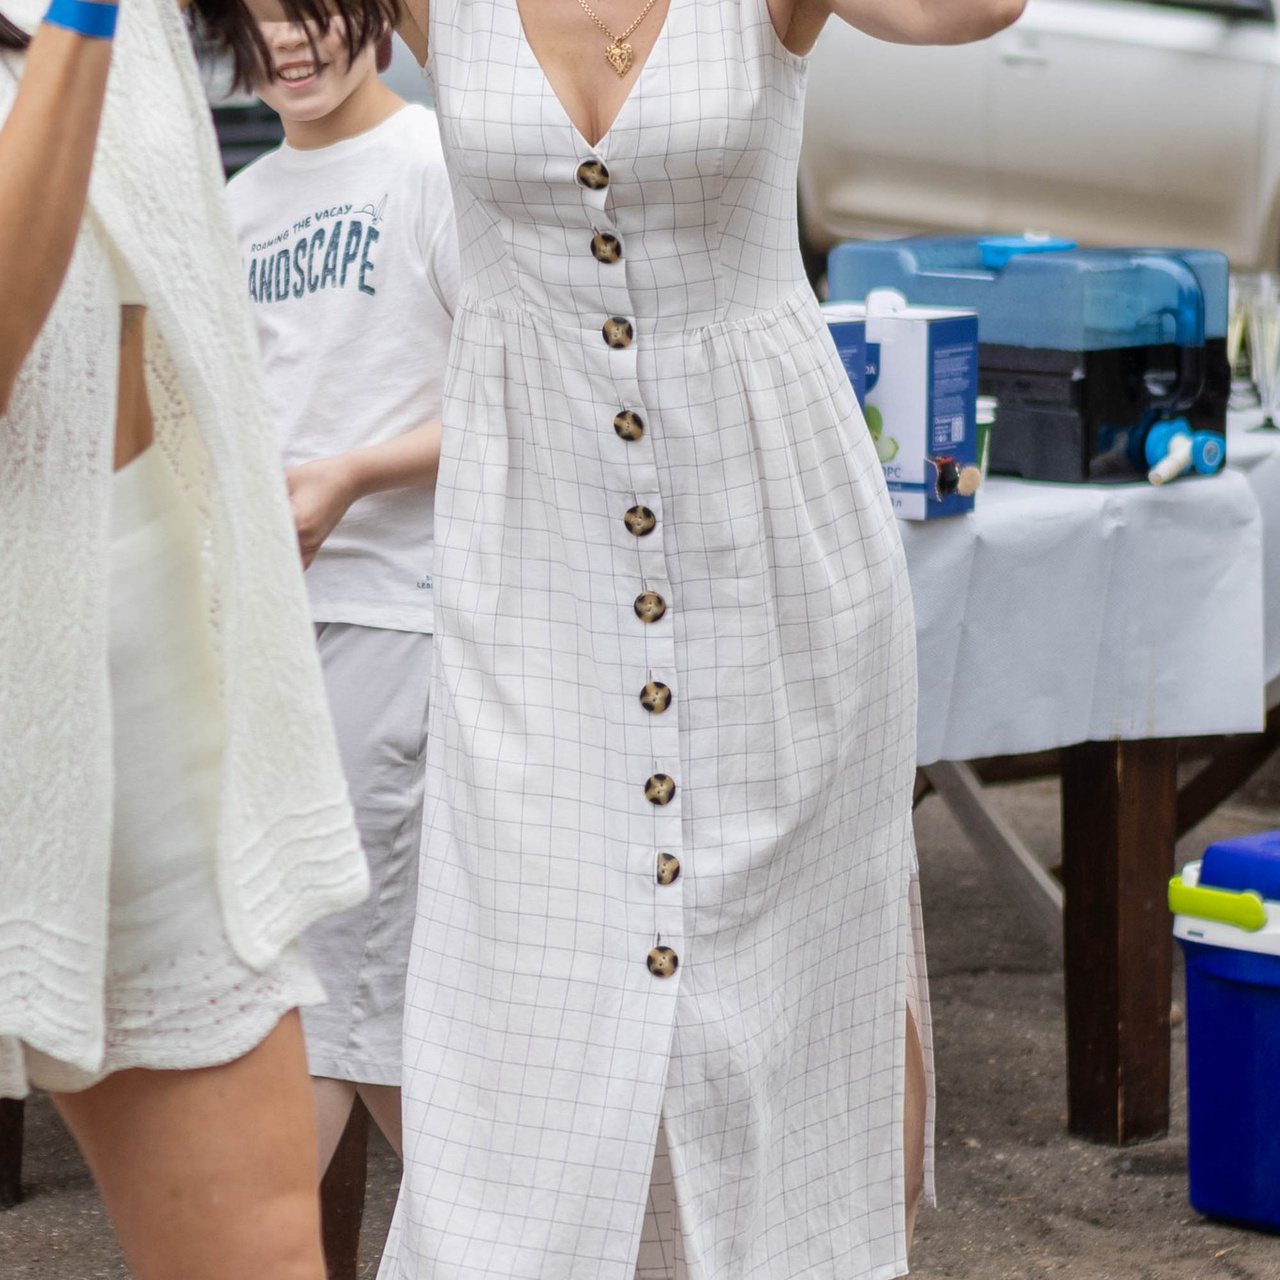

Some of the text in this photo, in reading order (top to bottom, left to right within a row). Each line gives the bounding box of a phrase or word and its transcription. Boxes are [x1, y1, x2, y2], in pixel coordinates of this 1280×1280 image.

[250, 204, 353, 253] ROAMING THE VACAY
[248, 220, 380, 304] ANDSCAPE
